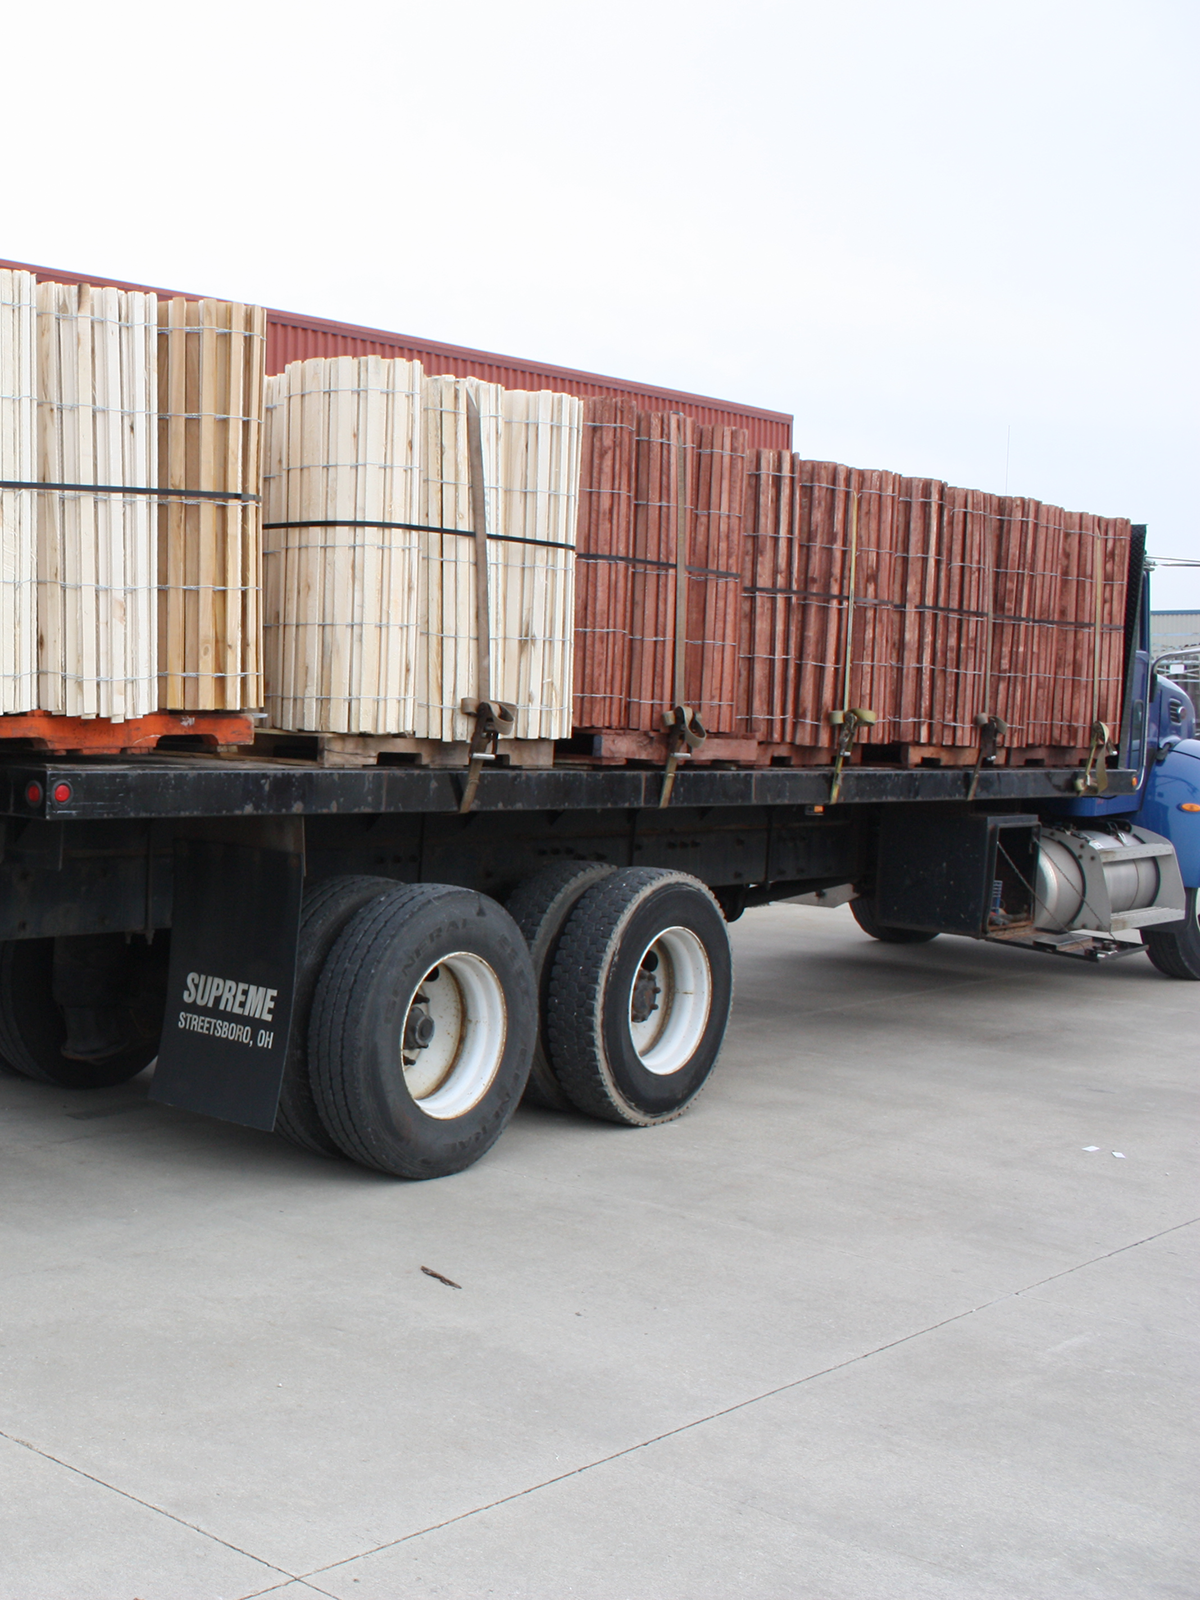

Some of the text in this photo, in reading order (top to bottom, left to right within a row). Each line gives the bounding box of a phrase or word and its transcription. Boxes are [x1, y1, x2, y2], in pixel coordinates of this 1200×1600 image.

[183, 972, 278, 1022] SUPREME
[178, 1011, 274, 1049] STREETSBORO, OH
